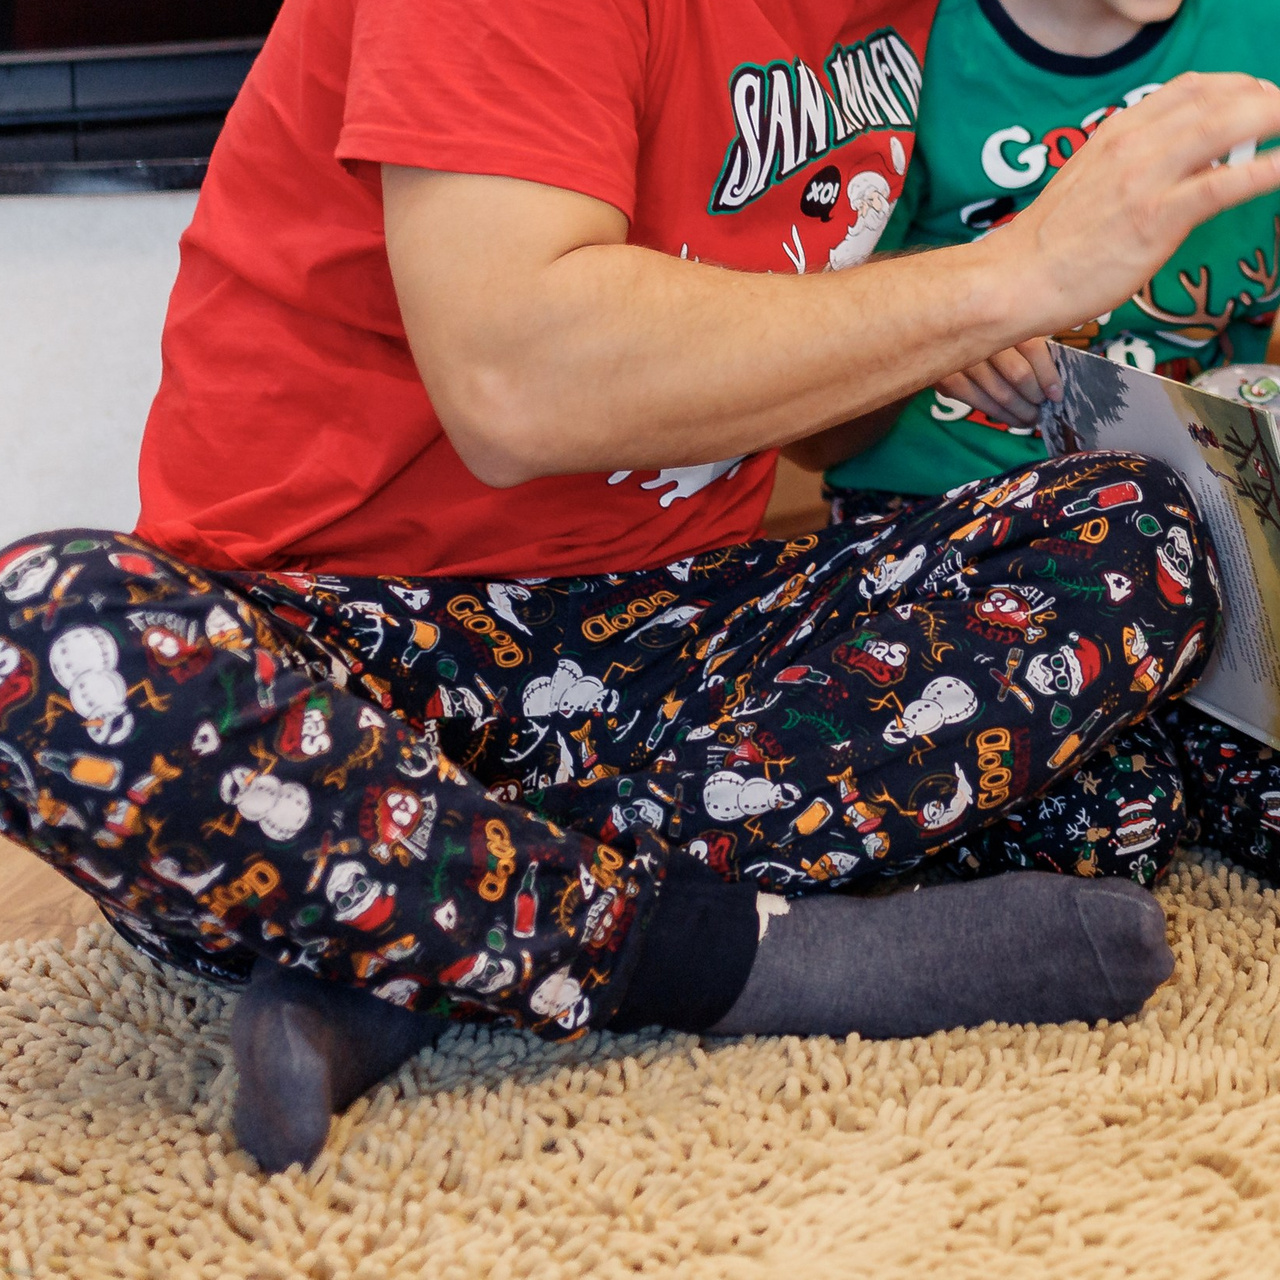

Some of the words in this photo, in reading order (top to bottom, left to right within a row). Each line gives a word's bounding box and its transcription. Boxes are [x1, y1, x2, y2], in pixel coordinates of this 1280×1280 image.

[719, 59, 846, 206] SAN
[446, 593, 524, 669] GOOD
[965, 614, 1020, 645] TASTY
[976, 727, 1012, 810] GOOD
